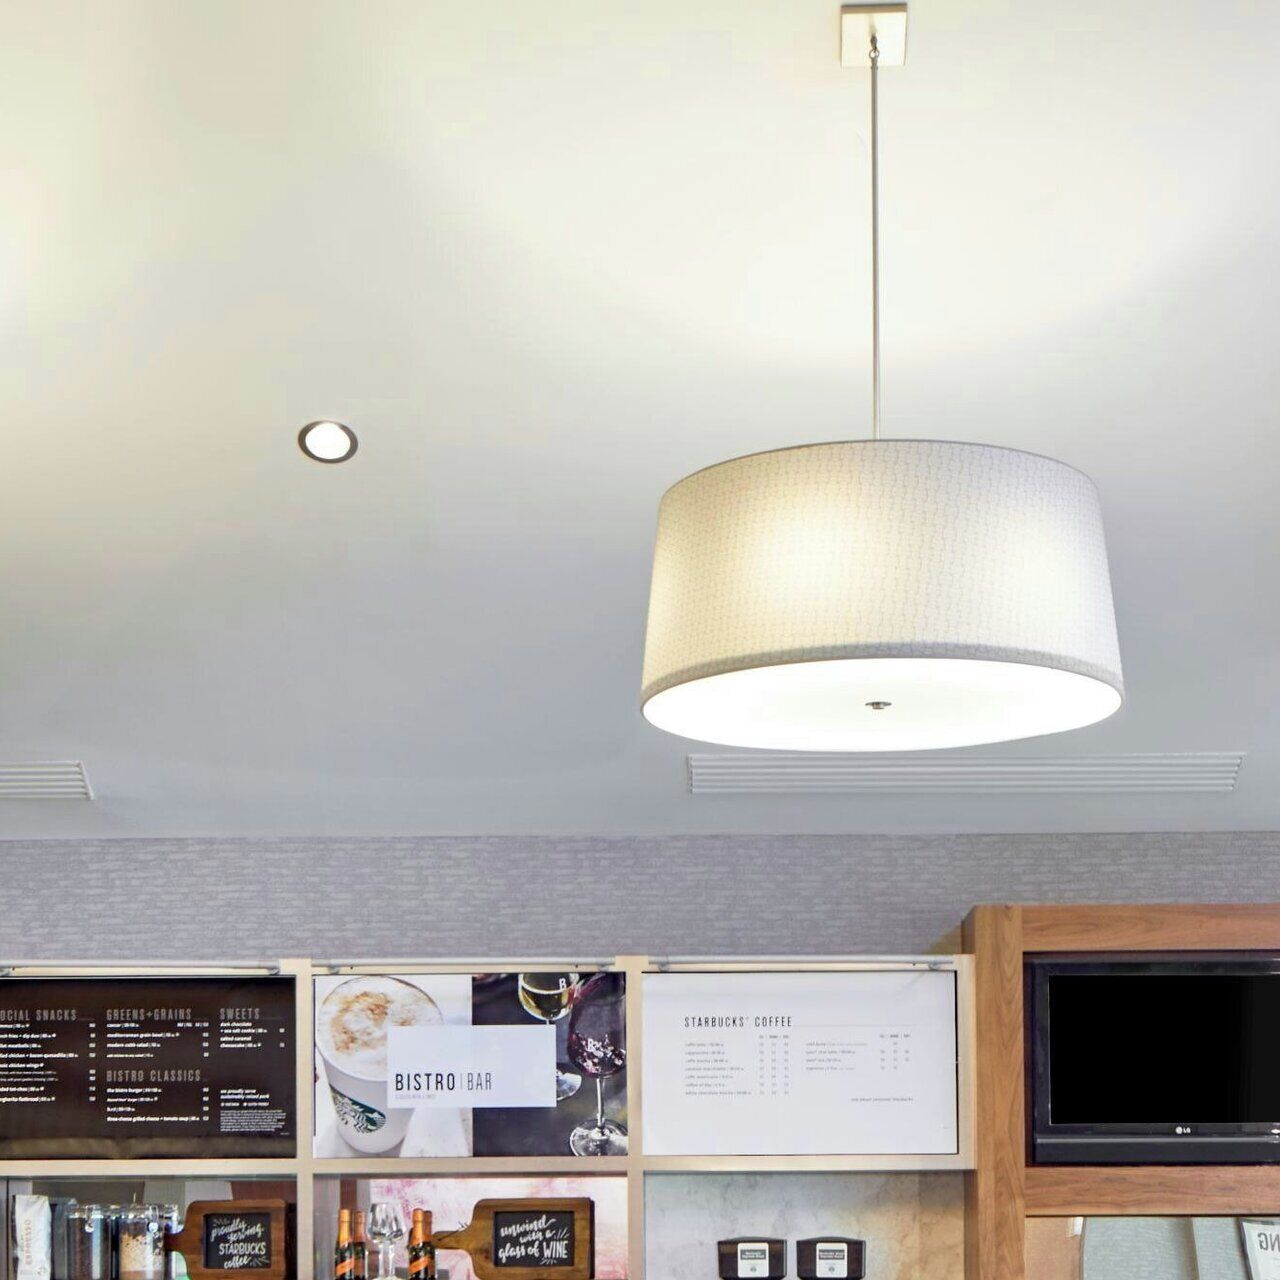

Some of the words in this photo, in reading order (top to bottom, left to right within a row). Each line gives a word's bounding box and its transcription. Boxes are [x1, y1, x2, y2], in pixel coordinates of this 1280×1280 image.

[36, 1009, 77, 1021] SNACKS
[106, 1009, 192, 1021] GREENS+GRAINS
[220, 1008, 260, 1020] SWEETS
[755, 1016, 792, 1027] COFFEE
[106, 1070, 145, 1082] BISTRO
[150, 1069, 200, 1082] CLASSICS
[395, 1073, 455, 1091] BISTRO
[467, 1072, 492, 1091] BAR
[210, 1217, 247, 1242] proudly
[227, 1223, 264, 1242] serving
[500, 1214, 554, 1237] unwind
[23, 1219, 33, 1265] ESPRESSO
[519, 1231, 543, 1243] with
[545, 1229, 556, 1239] a
[218, 1241, 266, 1256] STARBUCKS
[498, 1242, 526, 1264] glass
[526, 1240, 540, 1258] of
[542, 1240, 569, 1259] WINE
[223, 1254, 253, 1269] coffee
